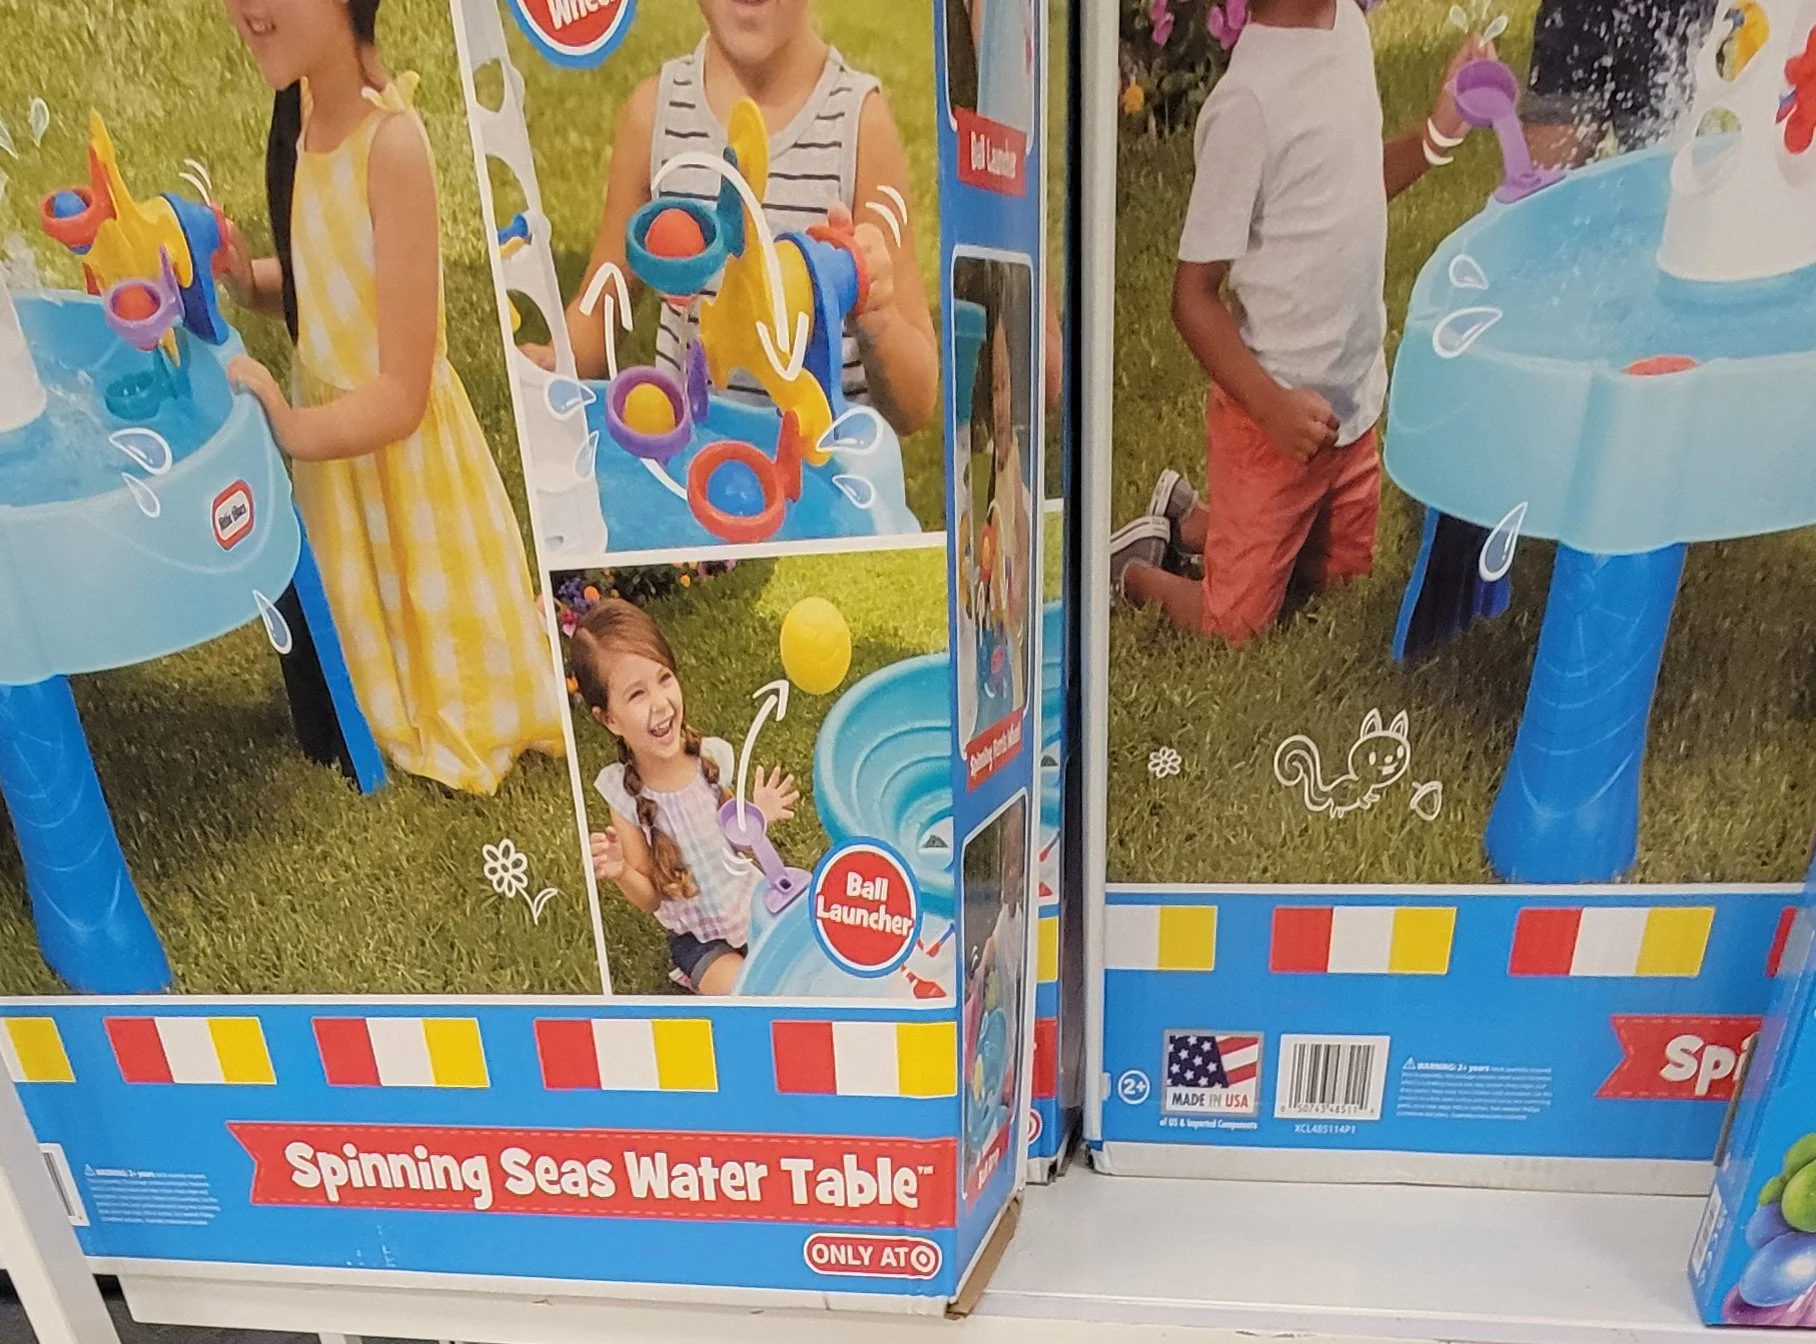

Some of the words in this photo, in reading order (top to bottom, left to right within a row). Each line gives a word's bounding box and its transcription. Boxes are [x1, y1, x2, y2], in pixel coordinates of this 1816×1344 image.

[547, 0, 616, 30] Whe
[846, 871, 889, 901] Ball
[816, 894, 914, 936] Launcher
[1123, 1078, 1146, 1095] 2+
[1172, 1092, 1205, 1107] MADE
[1209, 1094, 1222, 1107] IN
[1225, 1094, 1249, 1108] USA
[285, 1141, 493, 1210] Spinning
[500, 1147, 617, 1198] Seas
[623, 1151, 769, 1201] Water
[811, 1244, 873, 1267] ONLY
[880, 1246, 909, 1268] AT
